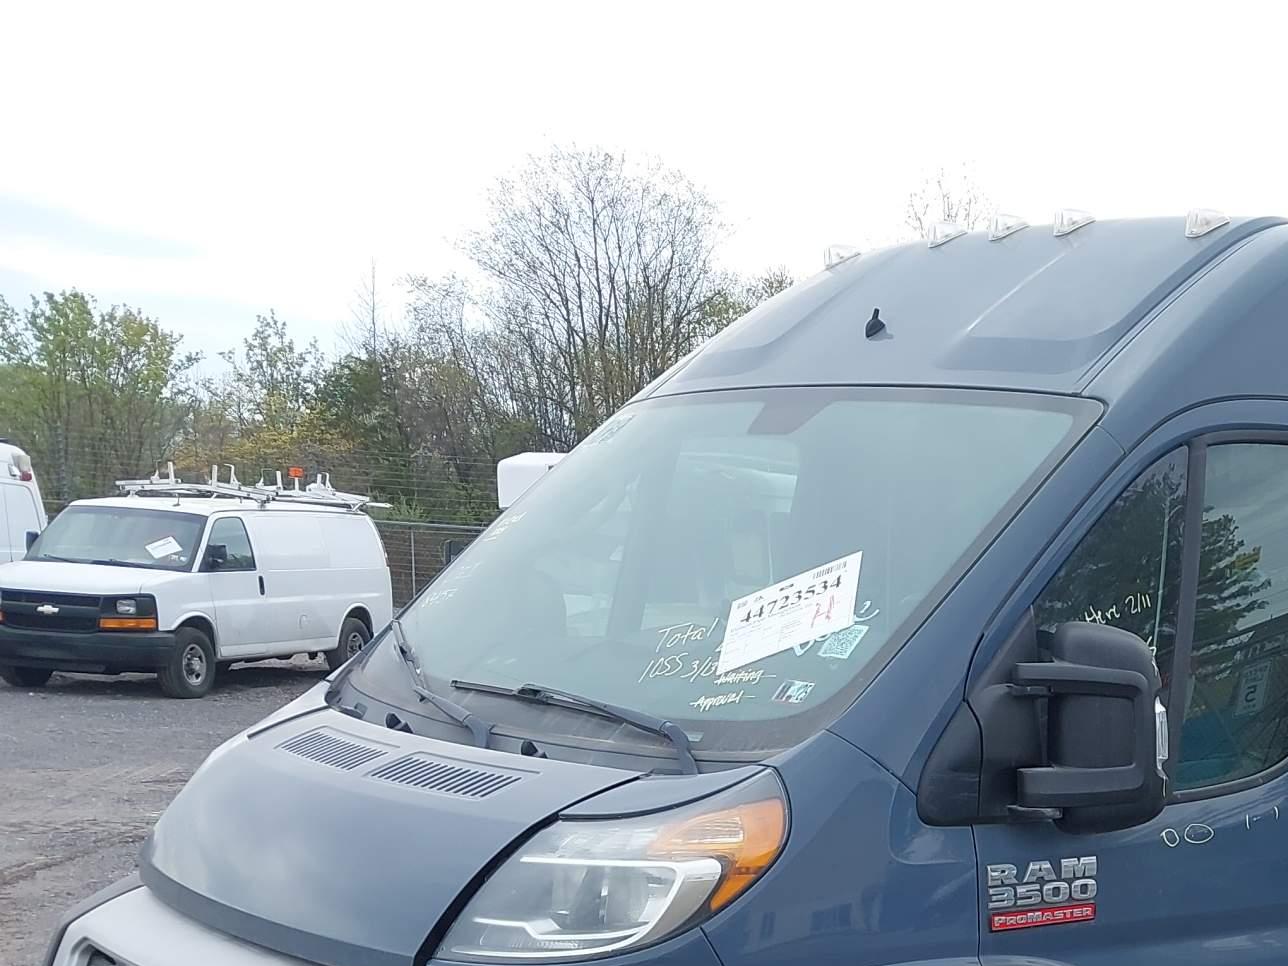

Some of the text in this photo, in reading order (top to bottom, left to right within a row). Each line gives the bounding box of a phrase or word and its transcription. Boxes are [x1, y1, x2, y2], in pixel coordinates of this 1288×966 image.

[740, 574, 842, 623] 44723534
[655, 617, 719, 653] Total
[987, 856, 1097, 886] RAM
[987, 878, 1097, 909] 3500
